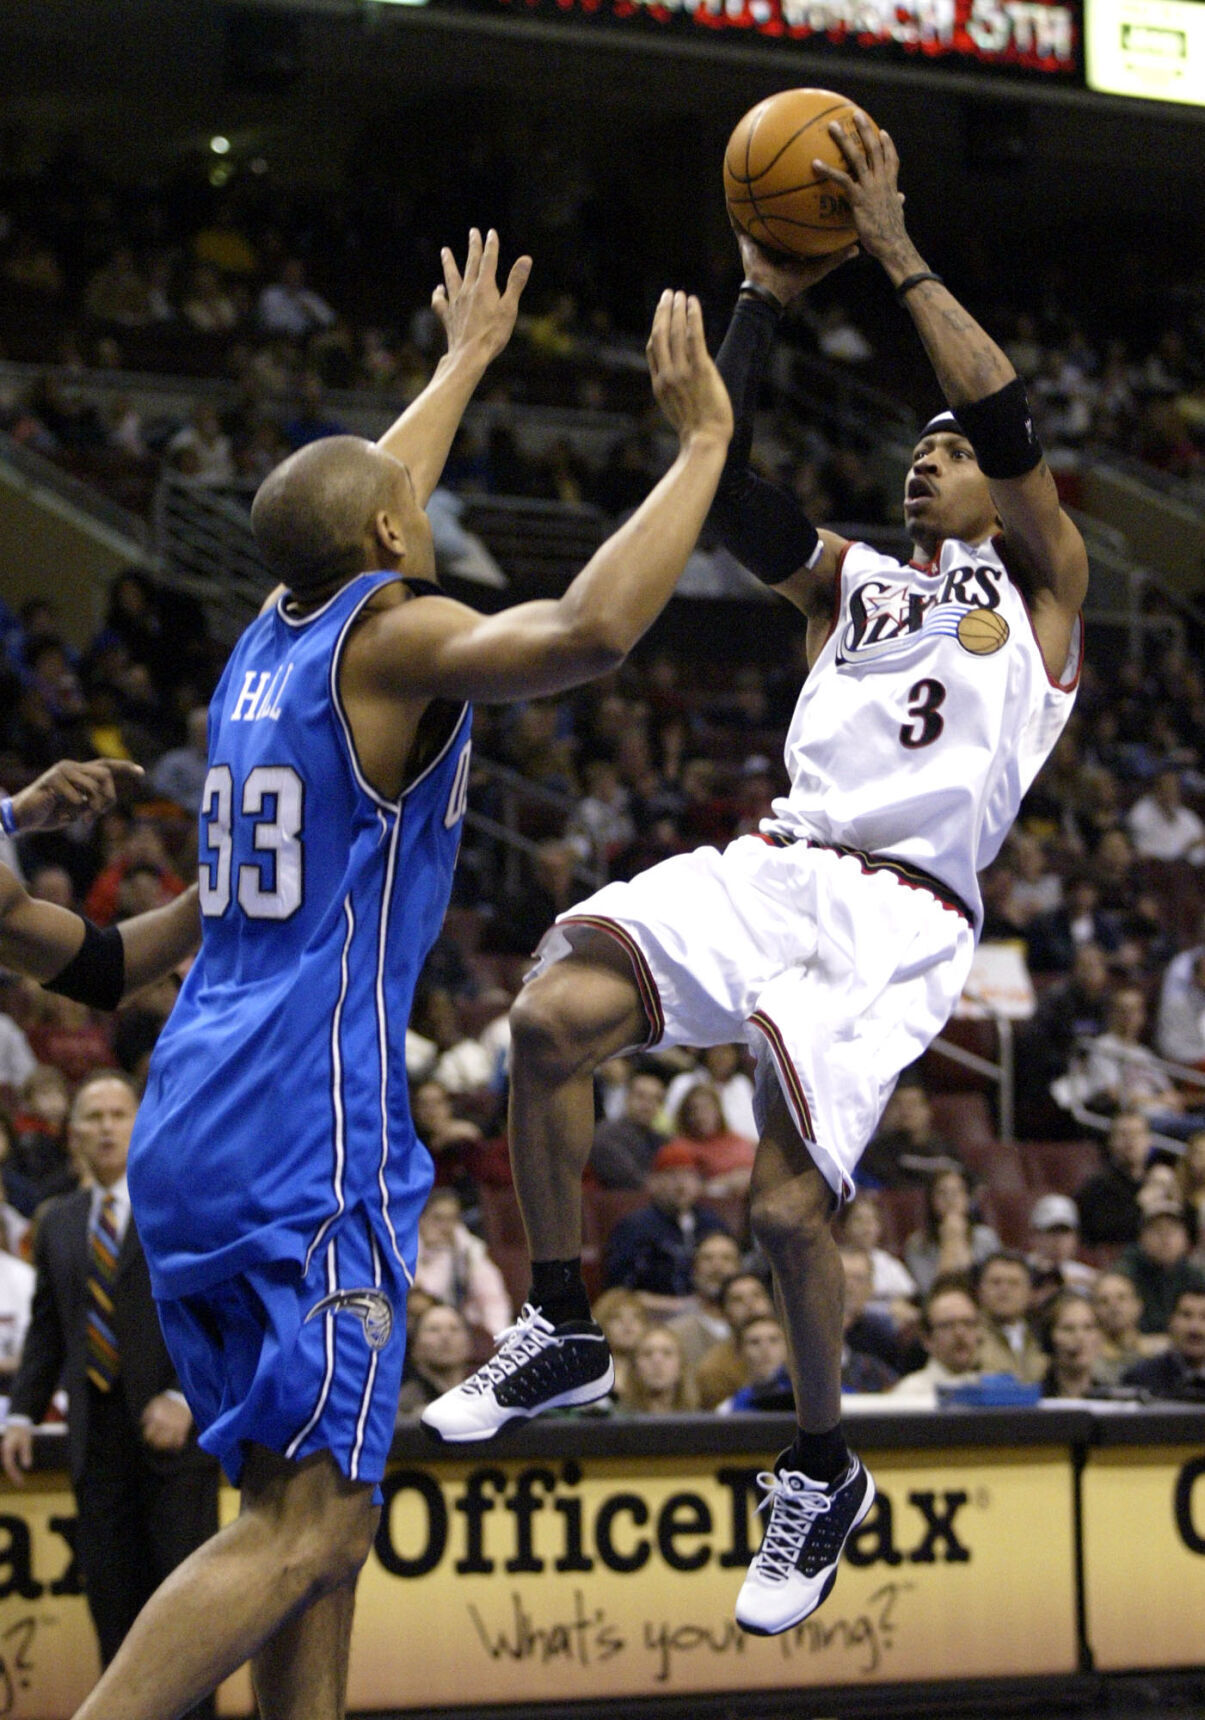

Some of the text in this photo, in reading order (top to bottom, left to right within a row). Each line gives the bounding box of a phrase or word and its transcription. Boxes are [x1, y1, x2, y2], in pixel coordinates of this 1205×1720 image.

[850, 566, 1002, 652] SIXRS
[899, 678, 946, 749] 3
[198, 764, 305, 919] 33
